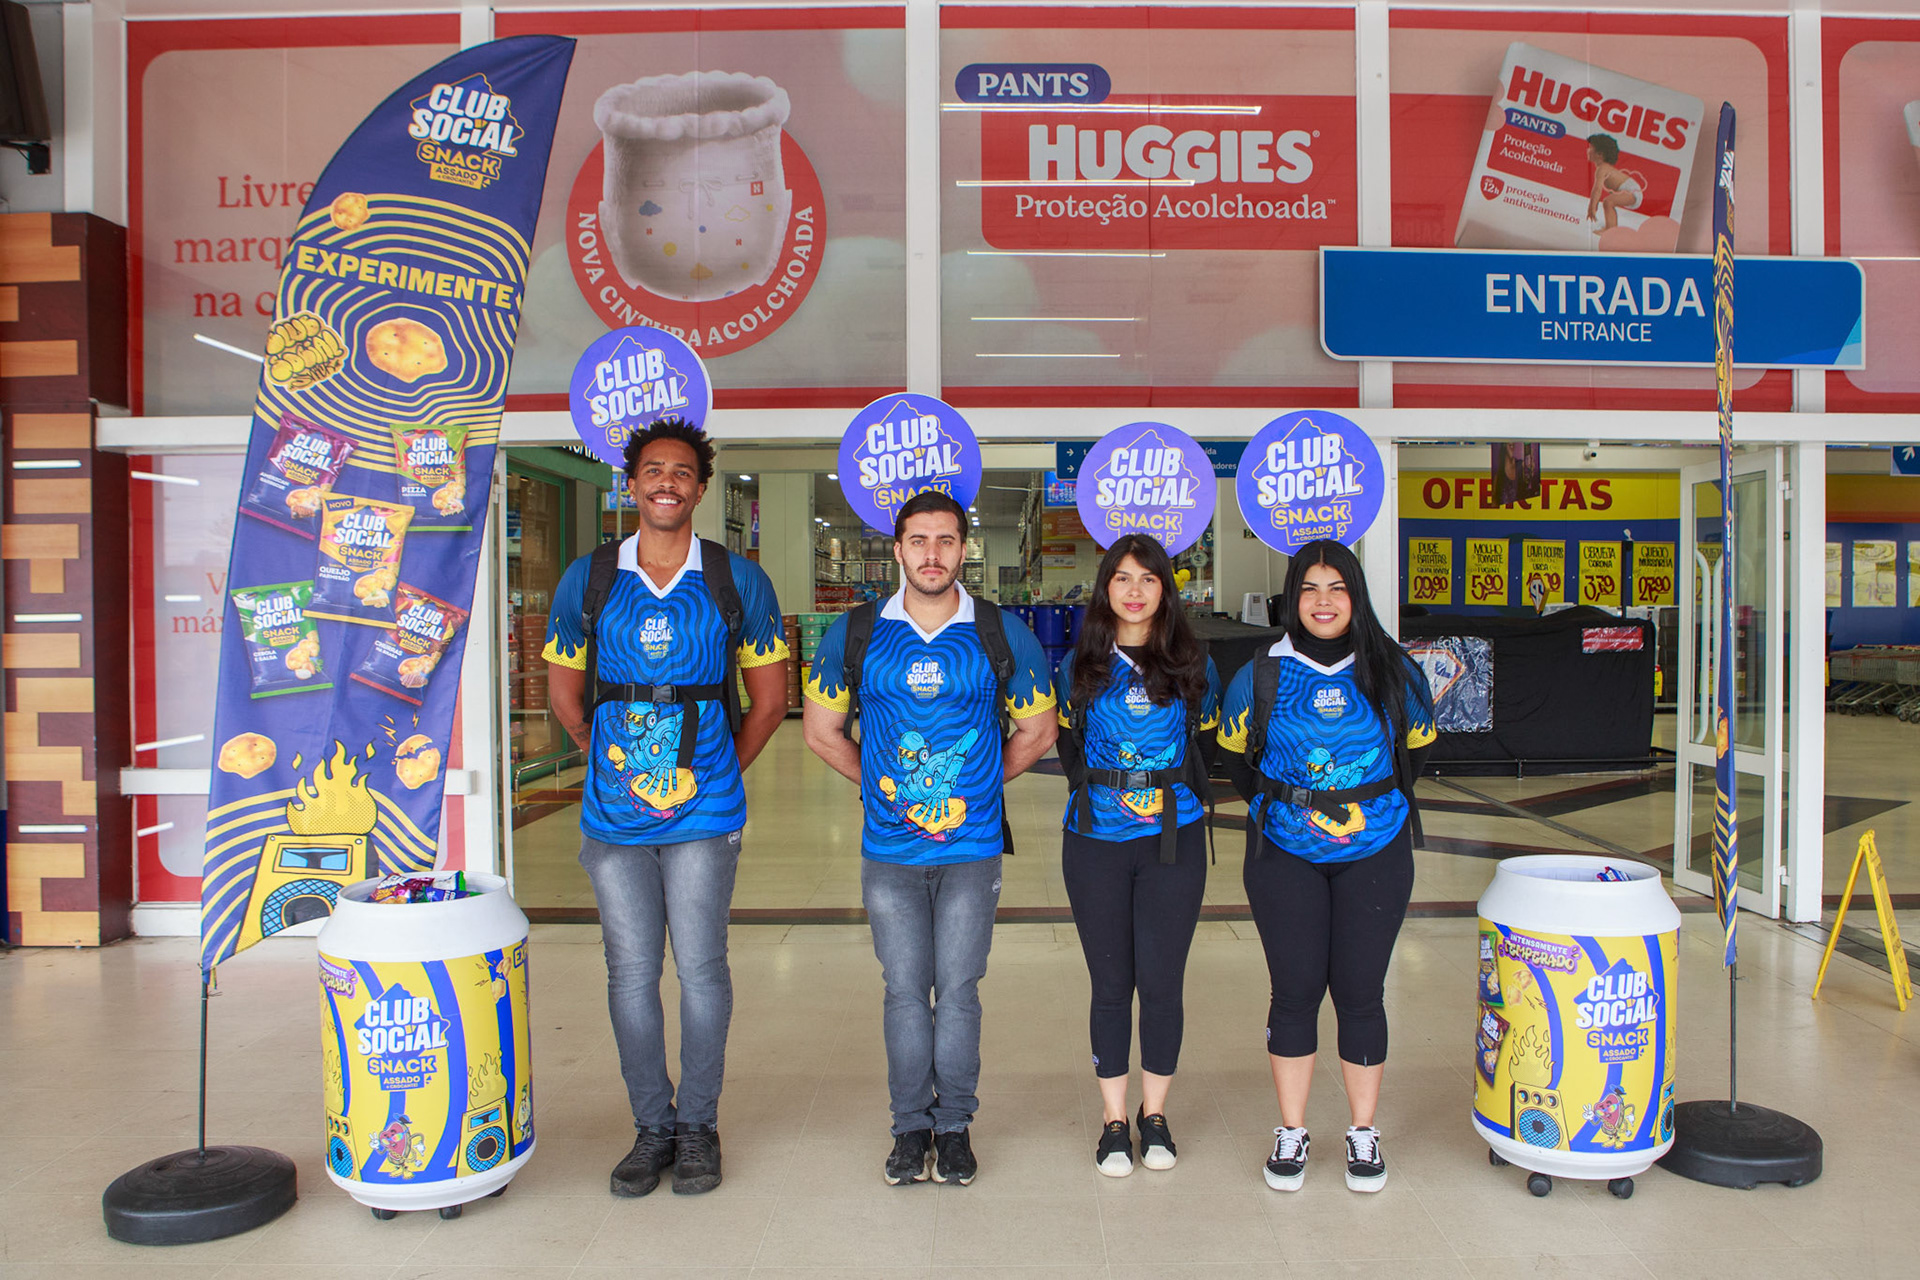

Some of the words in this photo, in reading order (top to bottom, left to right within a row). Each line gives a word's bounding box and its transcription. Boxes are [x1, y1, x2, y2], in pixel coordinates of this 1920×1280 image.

[977, 72, 1090, 97] PANTS
[428, 83, 508, 121] CLUB
[1506, 65, 1689, 151] HUGGIES
[1510, 112, 1558, 135] PANTS
[1503, 134, 1552, 157] Proteção
[420, 143, 498, 176] SNACK
[1500, 147, 1563, 174] Acolchoada
[436, 166, 479, 182] ASSADO
[1505, 186, 1550, 204] proteção
[1015, 194, 1147, 225] Proteção
[1503, 196, 1580, 225] antivazamentos
[173, 235, 292, 270] marq
[296, 244, 515, 310] EXPERIMENTE
[577, 212, 605, 285] NOVA
[706, 206, 814, 347] ACOLCHOADA
[193, 290, 243, 317] na
[1486, 273, 1706, 318] ENTRADA
[1540, 320, 1652, 342] ENTRANCE
[596, 349, 665, 393] CLUB
[293, 433, 332, 455] CLUB
[412, 437, 448, 452] CLUB
[867, 415, 939, 455] CLUB
[1110, 448, 1181, 477] CLUB
[1267, 434, 1341, 474] CLUB
[283, 460, 319, 480] SNACK
[414, 467, 450, 476] SNACK
[401, 486, 427, 494] PIZZA
[329, 500, 352, 509] NOVO
[1274, 504, 1349, 526] SNACK
[342, 513, 387, 532] CLUB
[1109, 511, 1179, 531] SNACK
[1292, 525, 1334, 537] ASSADO
[340, 546, 382, 561] SNACK
[1473, 543, 1503, 554] MOLHO
[1476, 554, 1504, 564] TOMATE
[1583, 546, 1616, 560] CERVEJA
[319, 566, 351, 576] QUEIJO
[1588, 559, 1613, 569] CORONA
[1471, 574, 1504, 601] 5,90
[1584, 575, 1618, 602] 3,79
[256, 595, 294, 616] CLUB
[407, 604, 444, 626] CLUB
[262, 626, 300, 639] SNACK
[398, 629, 431, 649] SNACK
[911, 662, 939, 673] CLUB
[1317, 688, 1341, 699] CLUB
[1510, 933, 1568, 955] INTENSAMENTE
[1504, 940, 1575, 972] TEMPERADO
[1587, 971, 1647, 1001] CLUB
[365, 997, 430, 1027] CLUB
[1588, 1030, 1647, 1046] SNACK
[1603, 1048, 1636, 1057] ASSADO
[369, 1057, 434, 1074] SNACK
[384, 1075, 420, 1085] ASSADO
